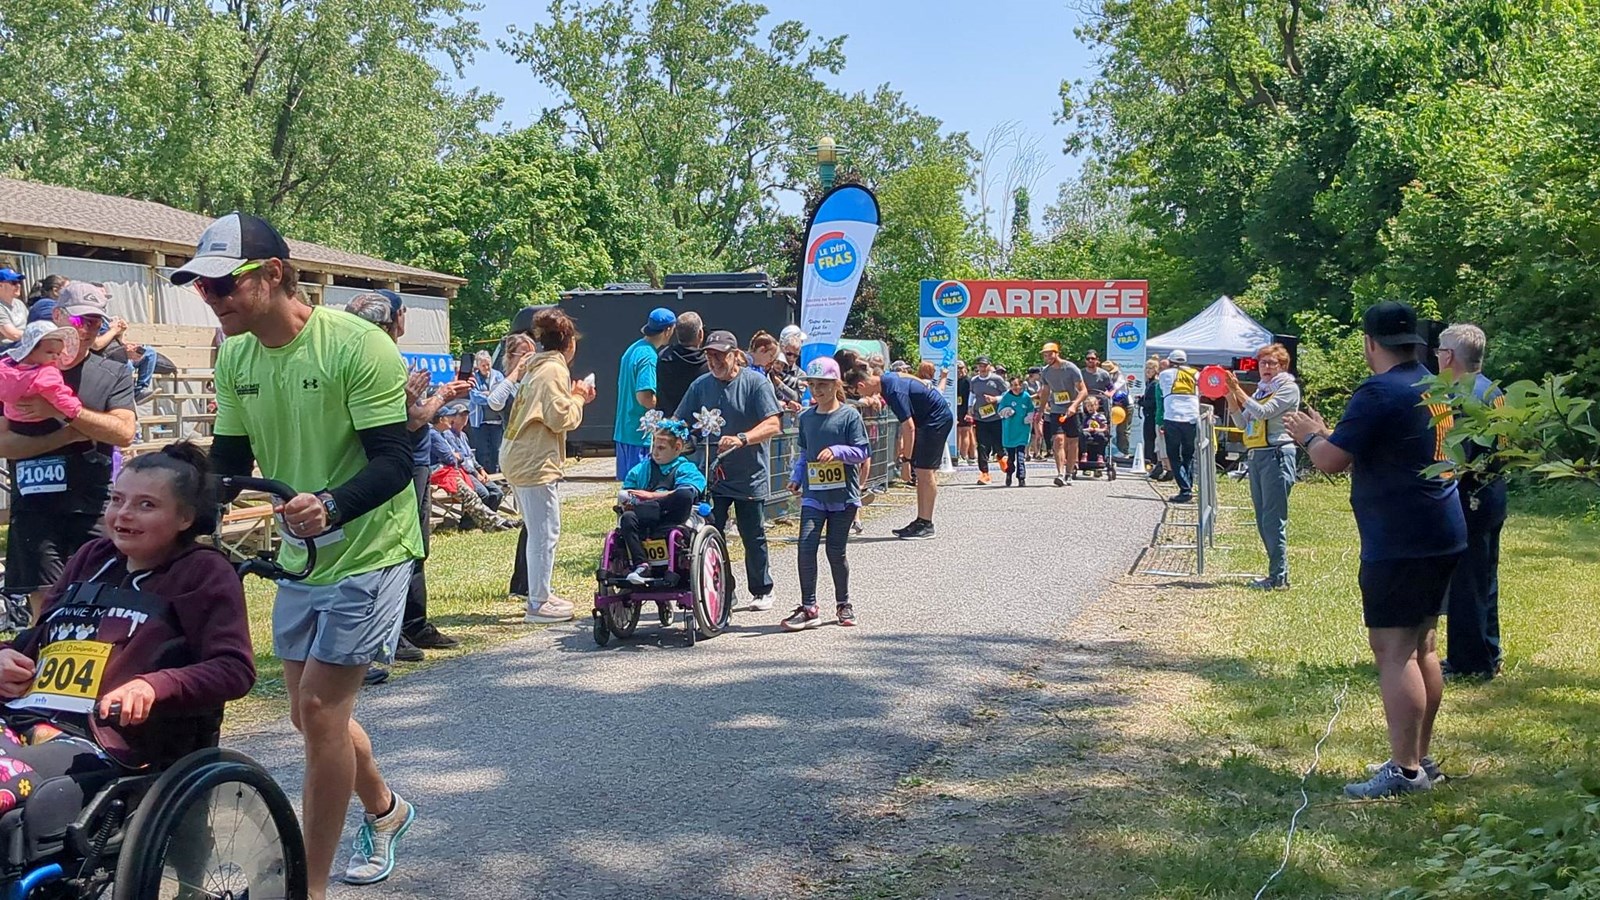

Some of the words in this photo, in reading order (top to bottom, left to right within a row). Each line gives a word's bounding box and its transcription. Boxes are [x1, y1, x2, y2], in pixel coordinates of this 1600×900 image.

[819, 248, 829, 256] LE
[830, 243, 847, 252] DÉFI
[818, 251, 853, 270] FRAS
[942, 295, 963, 306] FRAS
[978, 282, 1145, 315] ARRIVÉE
[928, 334, 949, 344] FRAS
[1116, 334, 1138, 345] FRAS
[24, 464, 65, 484] 1040
[818, 467, 842, 483] 909
[37, 656, 97, 694] 904
